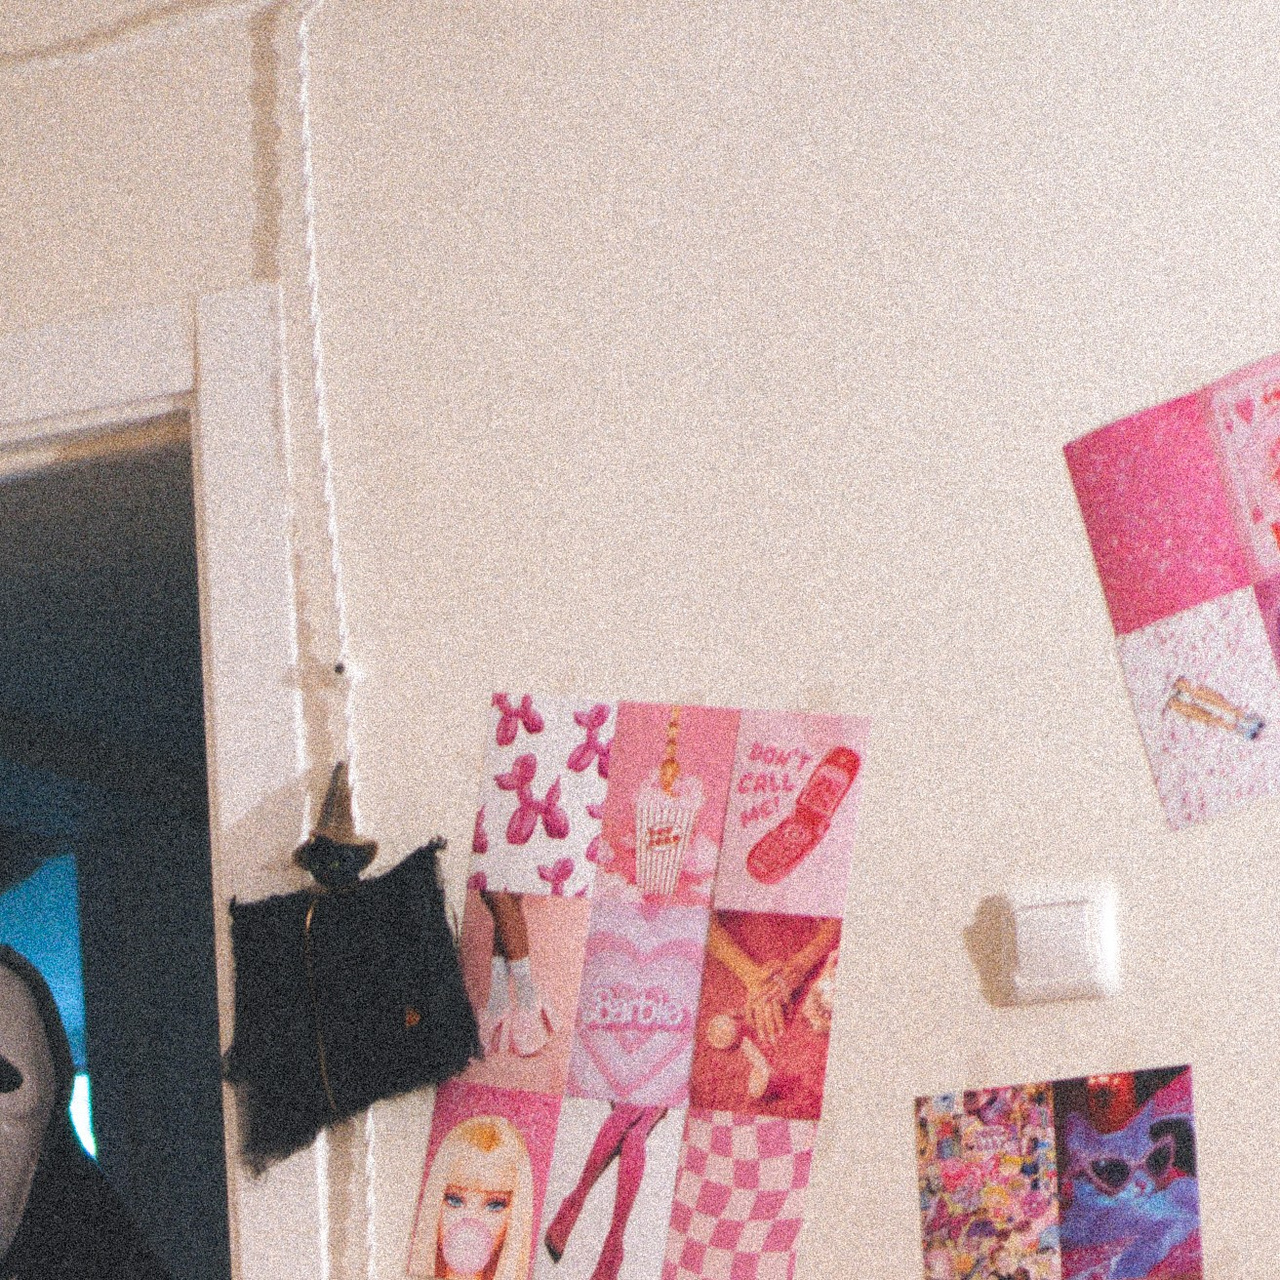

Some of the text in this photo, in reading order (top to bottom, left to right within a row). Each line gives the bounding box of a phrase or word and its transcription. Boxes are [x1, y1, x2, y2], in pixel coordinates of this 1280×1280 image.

[748, 742, 812, 771] DON'T
[737, 771, 794, 795] CALL
[582, 985, 683, 1027] Barbie
